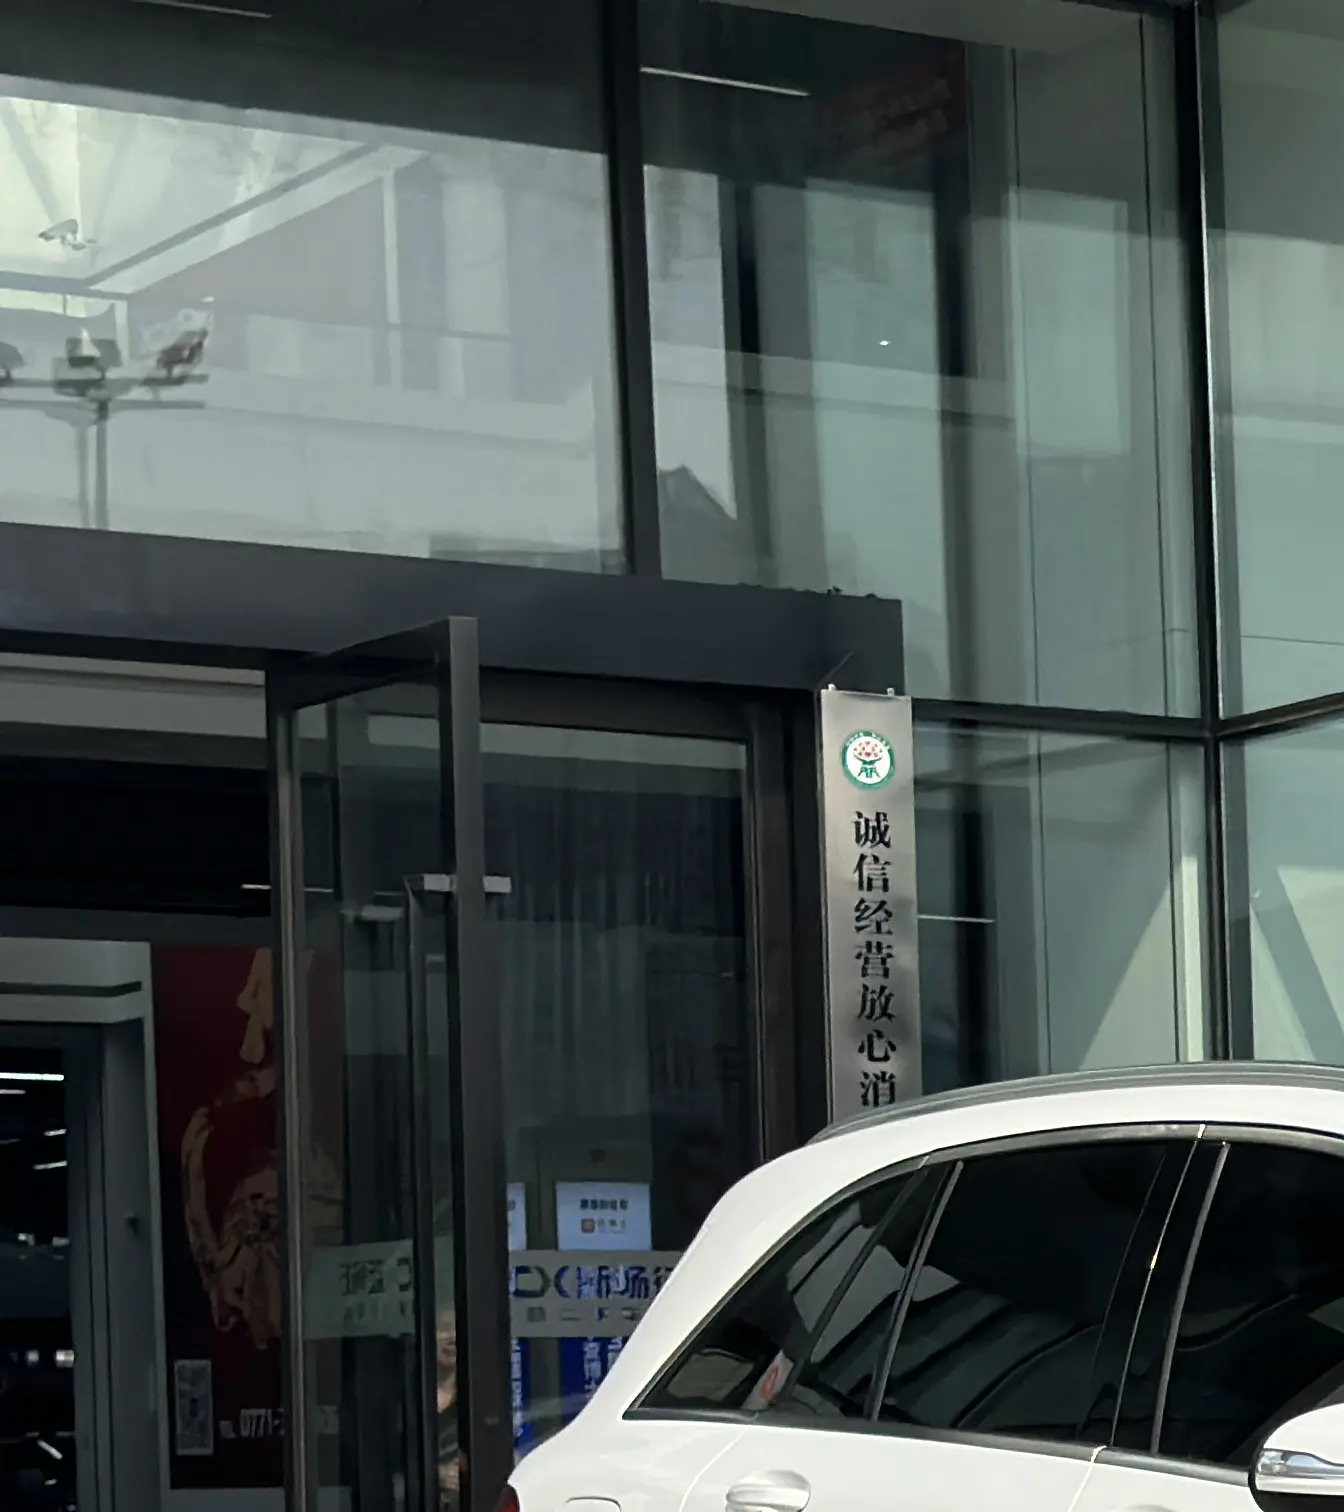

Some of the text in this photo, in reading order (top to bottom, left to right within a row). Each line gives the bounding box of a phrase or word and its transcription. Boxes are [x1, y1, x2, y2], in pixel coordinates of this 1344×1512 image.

[852, 811, 898, 1108] 诚信经营放心消
